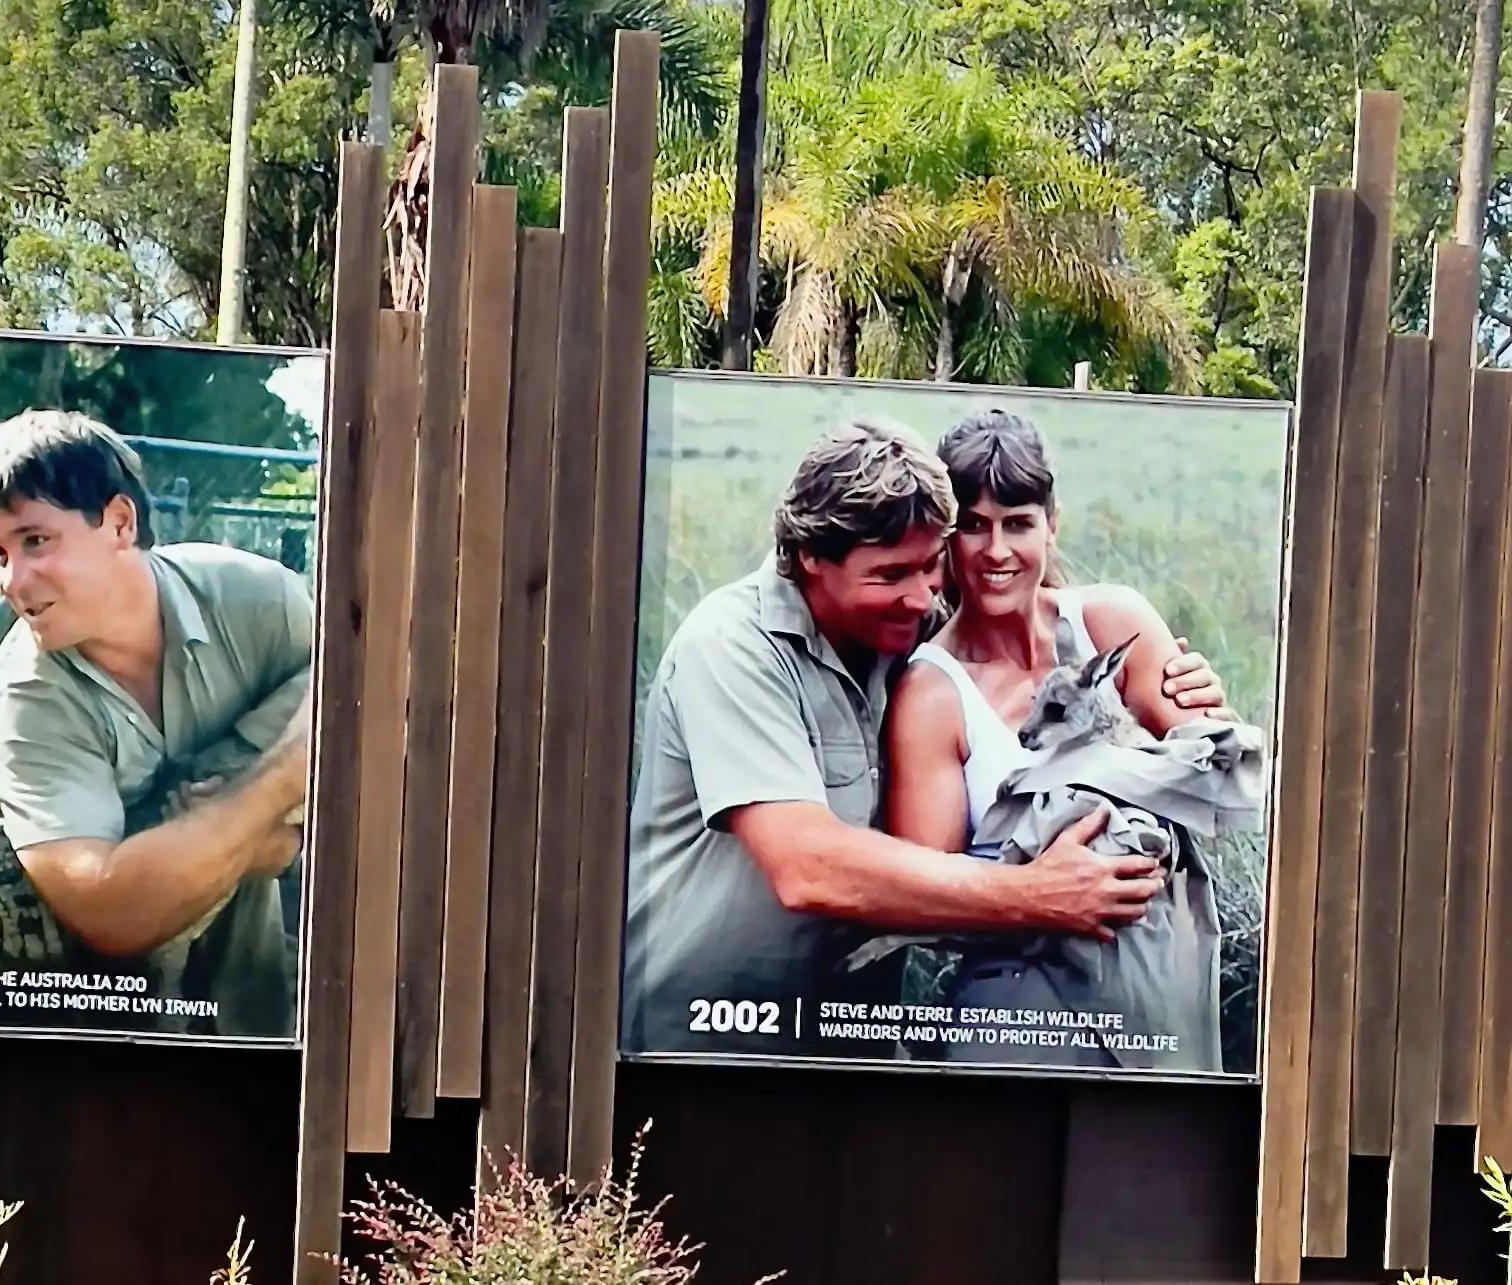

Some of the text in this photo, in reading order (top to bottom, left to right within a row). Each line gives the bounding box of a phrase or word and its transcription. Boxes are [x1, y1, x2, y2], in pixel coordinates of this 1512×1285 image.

[20, 972, 112, 991] AUSTRALIA
[114, 976, 147, 993] ZOO
[5, 991, 27, 1007] TO
[30, 992, 61, 1009] HIS
[63, 994, 129, 1012] MOTHER
[133, 998, 161, 1014] LYN
[164, 998, 218, 1017] IRWIN
[689, 1000, 780, 1034] 2002
[820, 1002, 1124, 1030] STEVE AND TERRI ESTABLISH WILDLIFE
[819, 1022, 1179, 1052] WARRIORS AND VOW TO PROTECT ALL WILDLIFE
